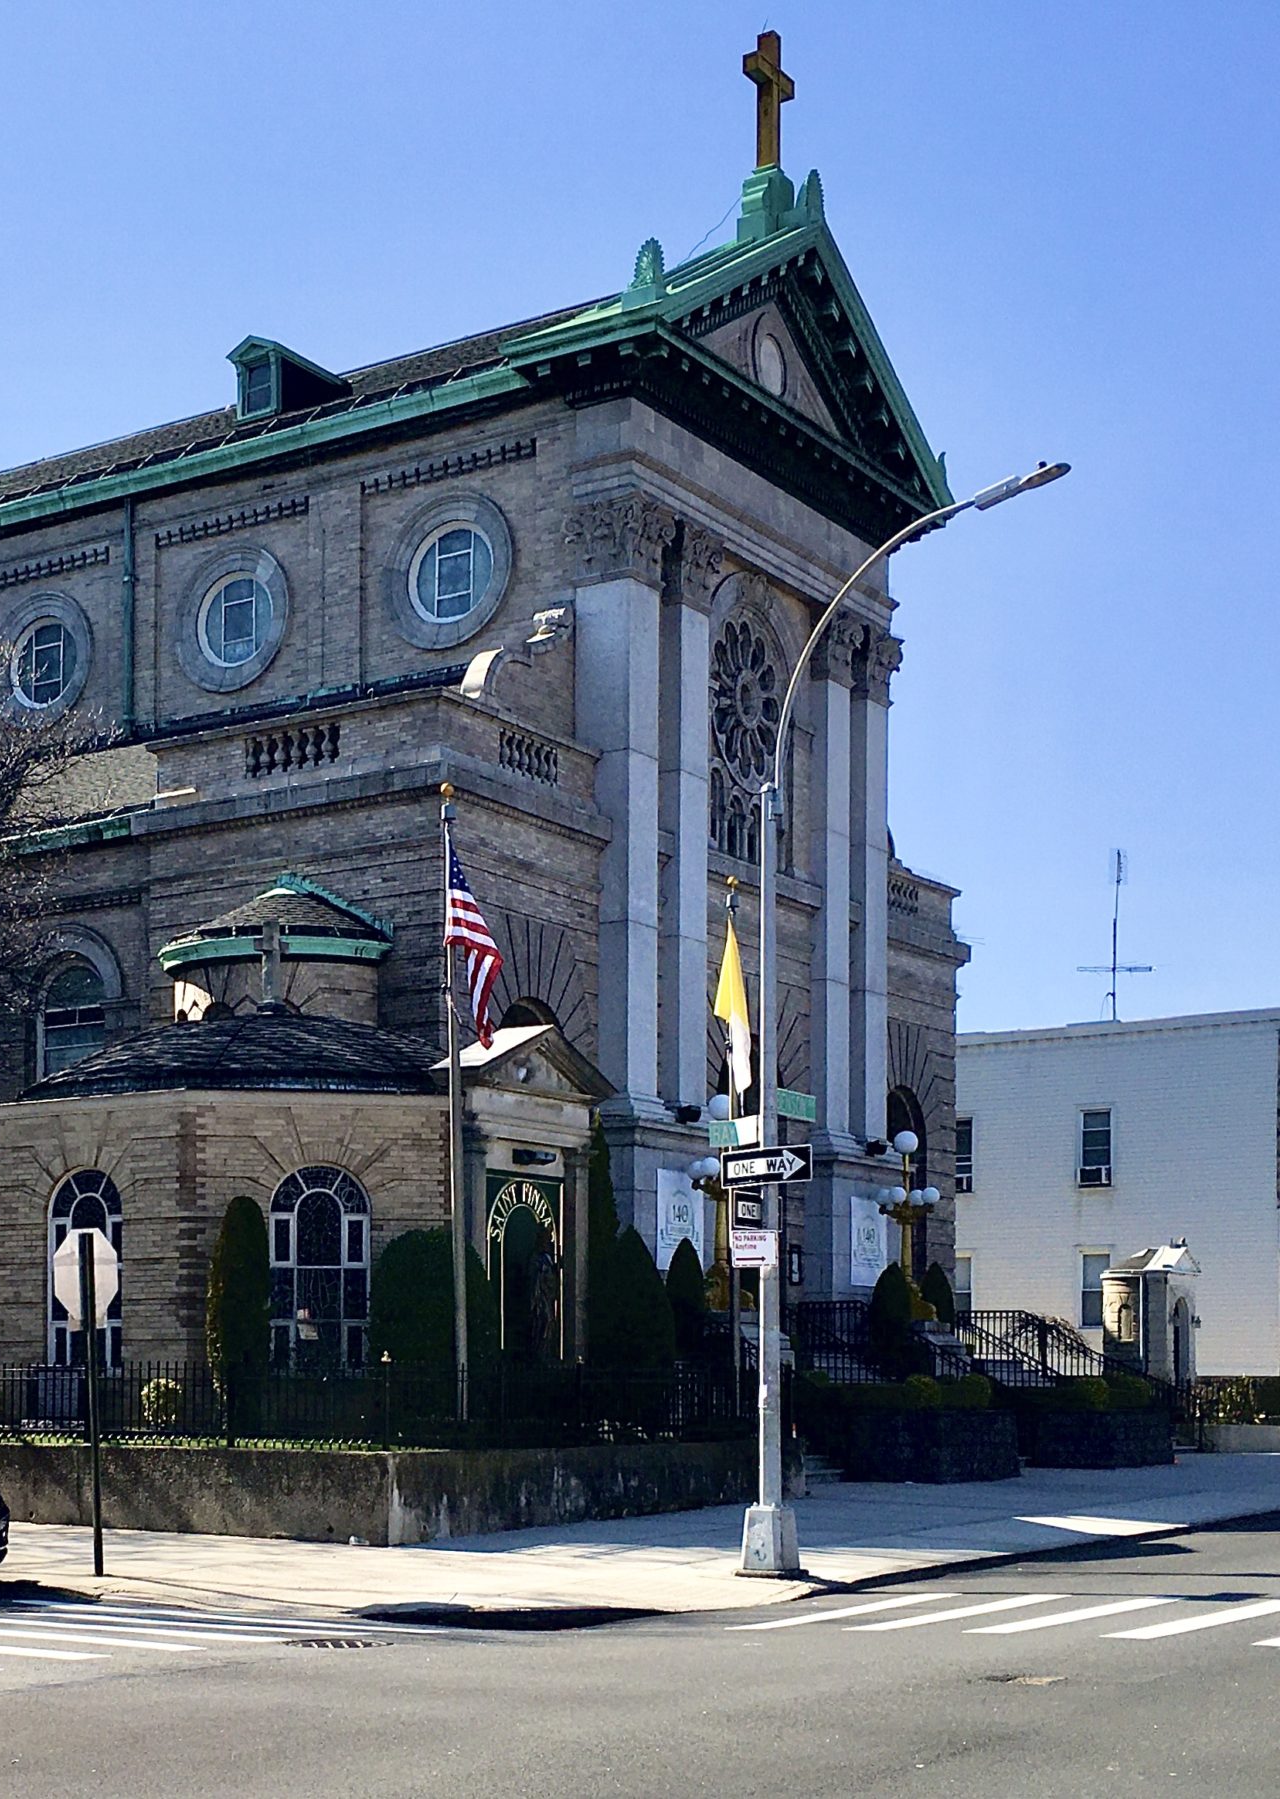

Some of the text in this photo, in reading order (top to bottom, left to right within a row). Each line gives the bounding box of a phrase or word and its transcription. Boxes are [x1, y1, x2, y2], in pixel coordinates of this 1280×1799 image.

[733, 1158, 796, 1176] ONE WAY
[490, 1184, 517, 1243] SAINT
[672, 1204, 689, 1223] 140
[741, 1203, 756, 1218] ONE
[735, 1243, 757, 1251] Anytime
